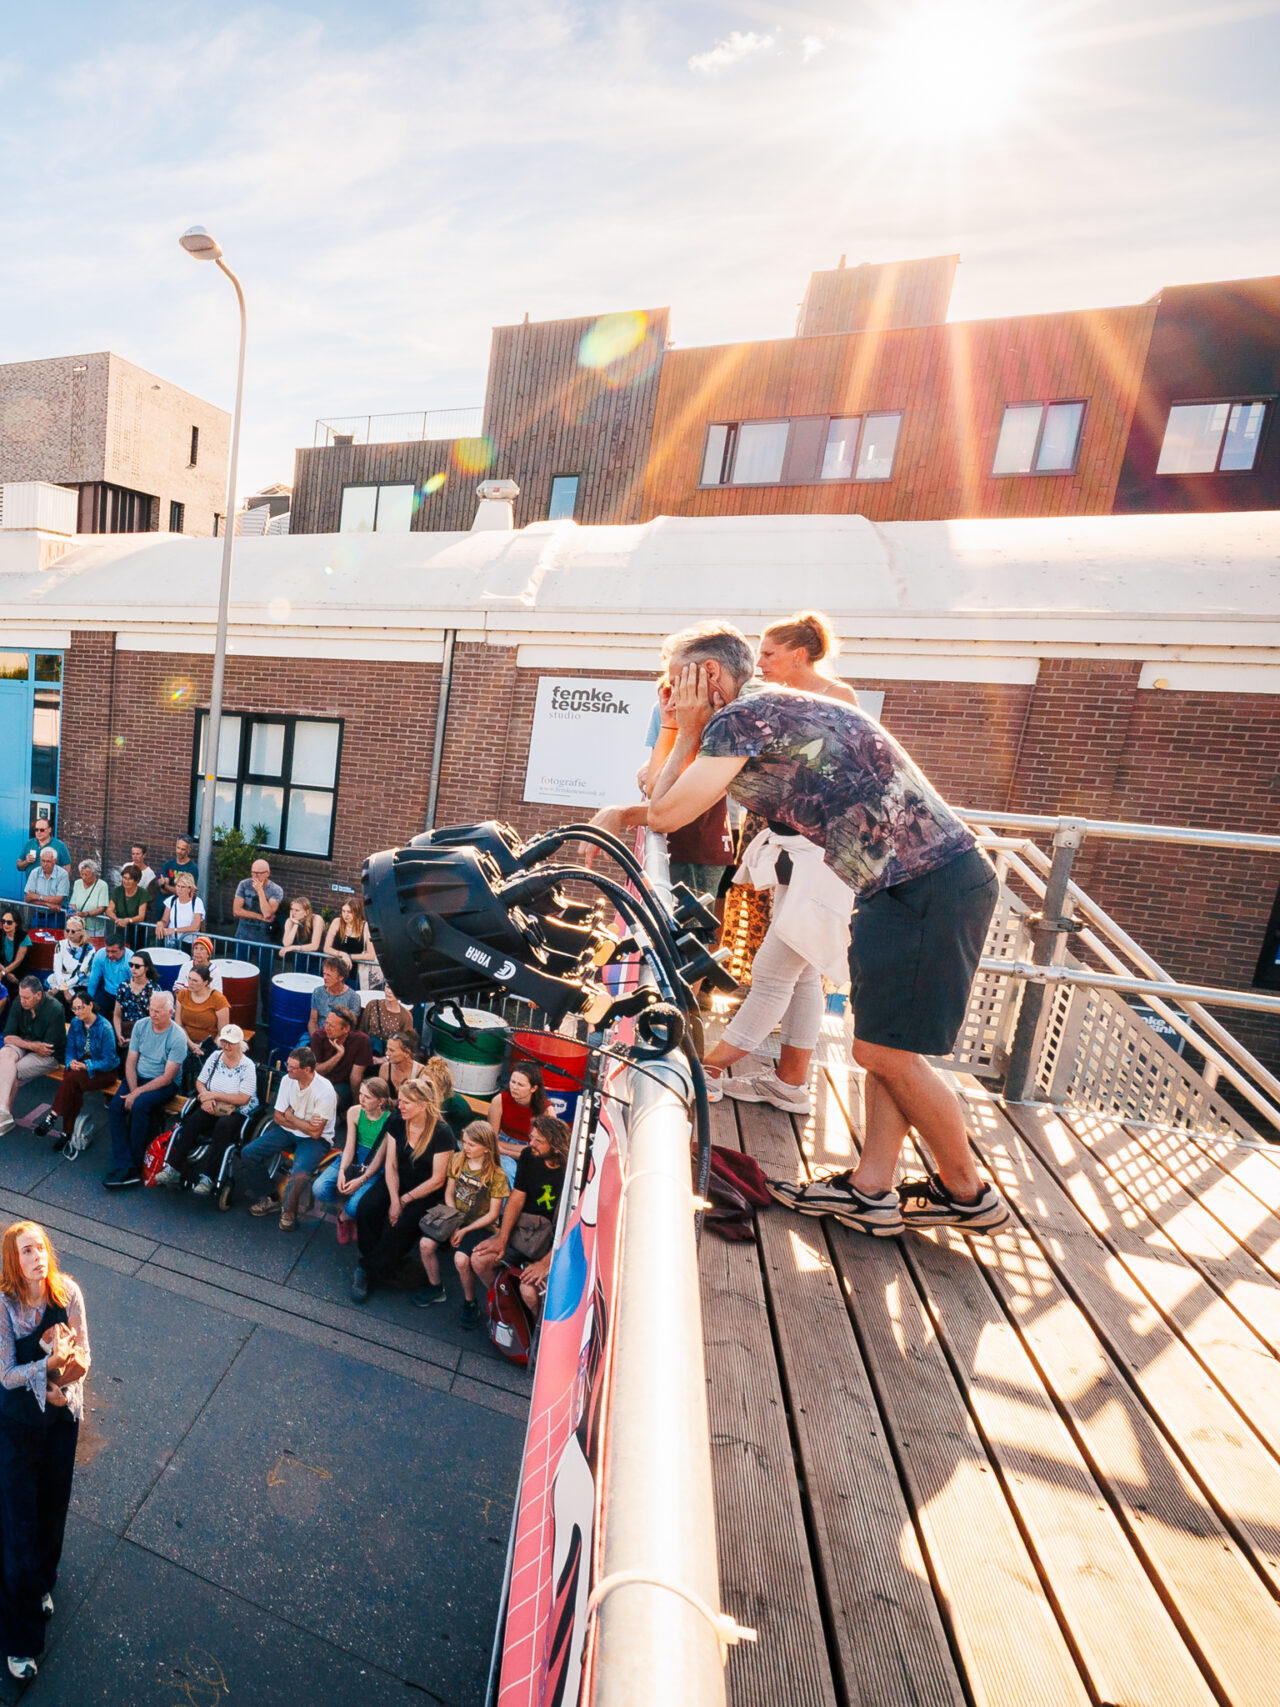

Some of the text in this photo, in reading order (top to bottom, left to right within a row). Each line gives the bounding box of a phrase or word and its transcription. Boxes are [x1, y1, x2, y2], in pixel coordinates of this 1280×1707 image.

[553, 686, 613, 702] femke
[551, 698, 630, 714] teussink
[548, 711, 581, 720] studio
[540, 776, 587, 788] fotografie
[464, 945, 492, 968] YARA
